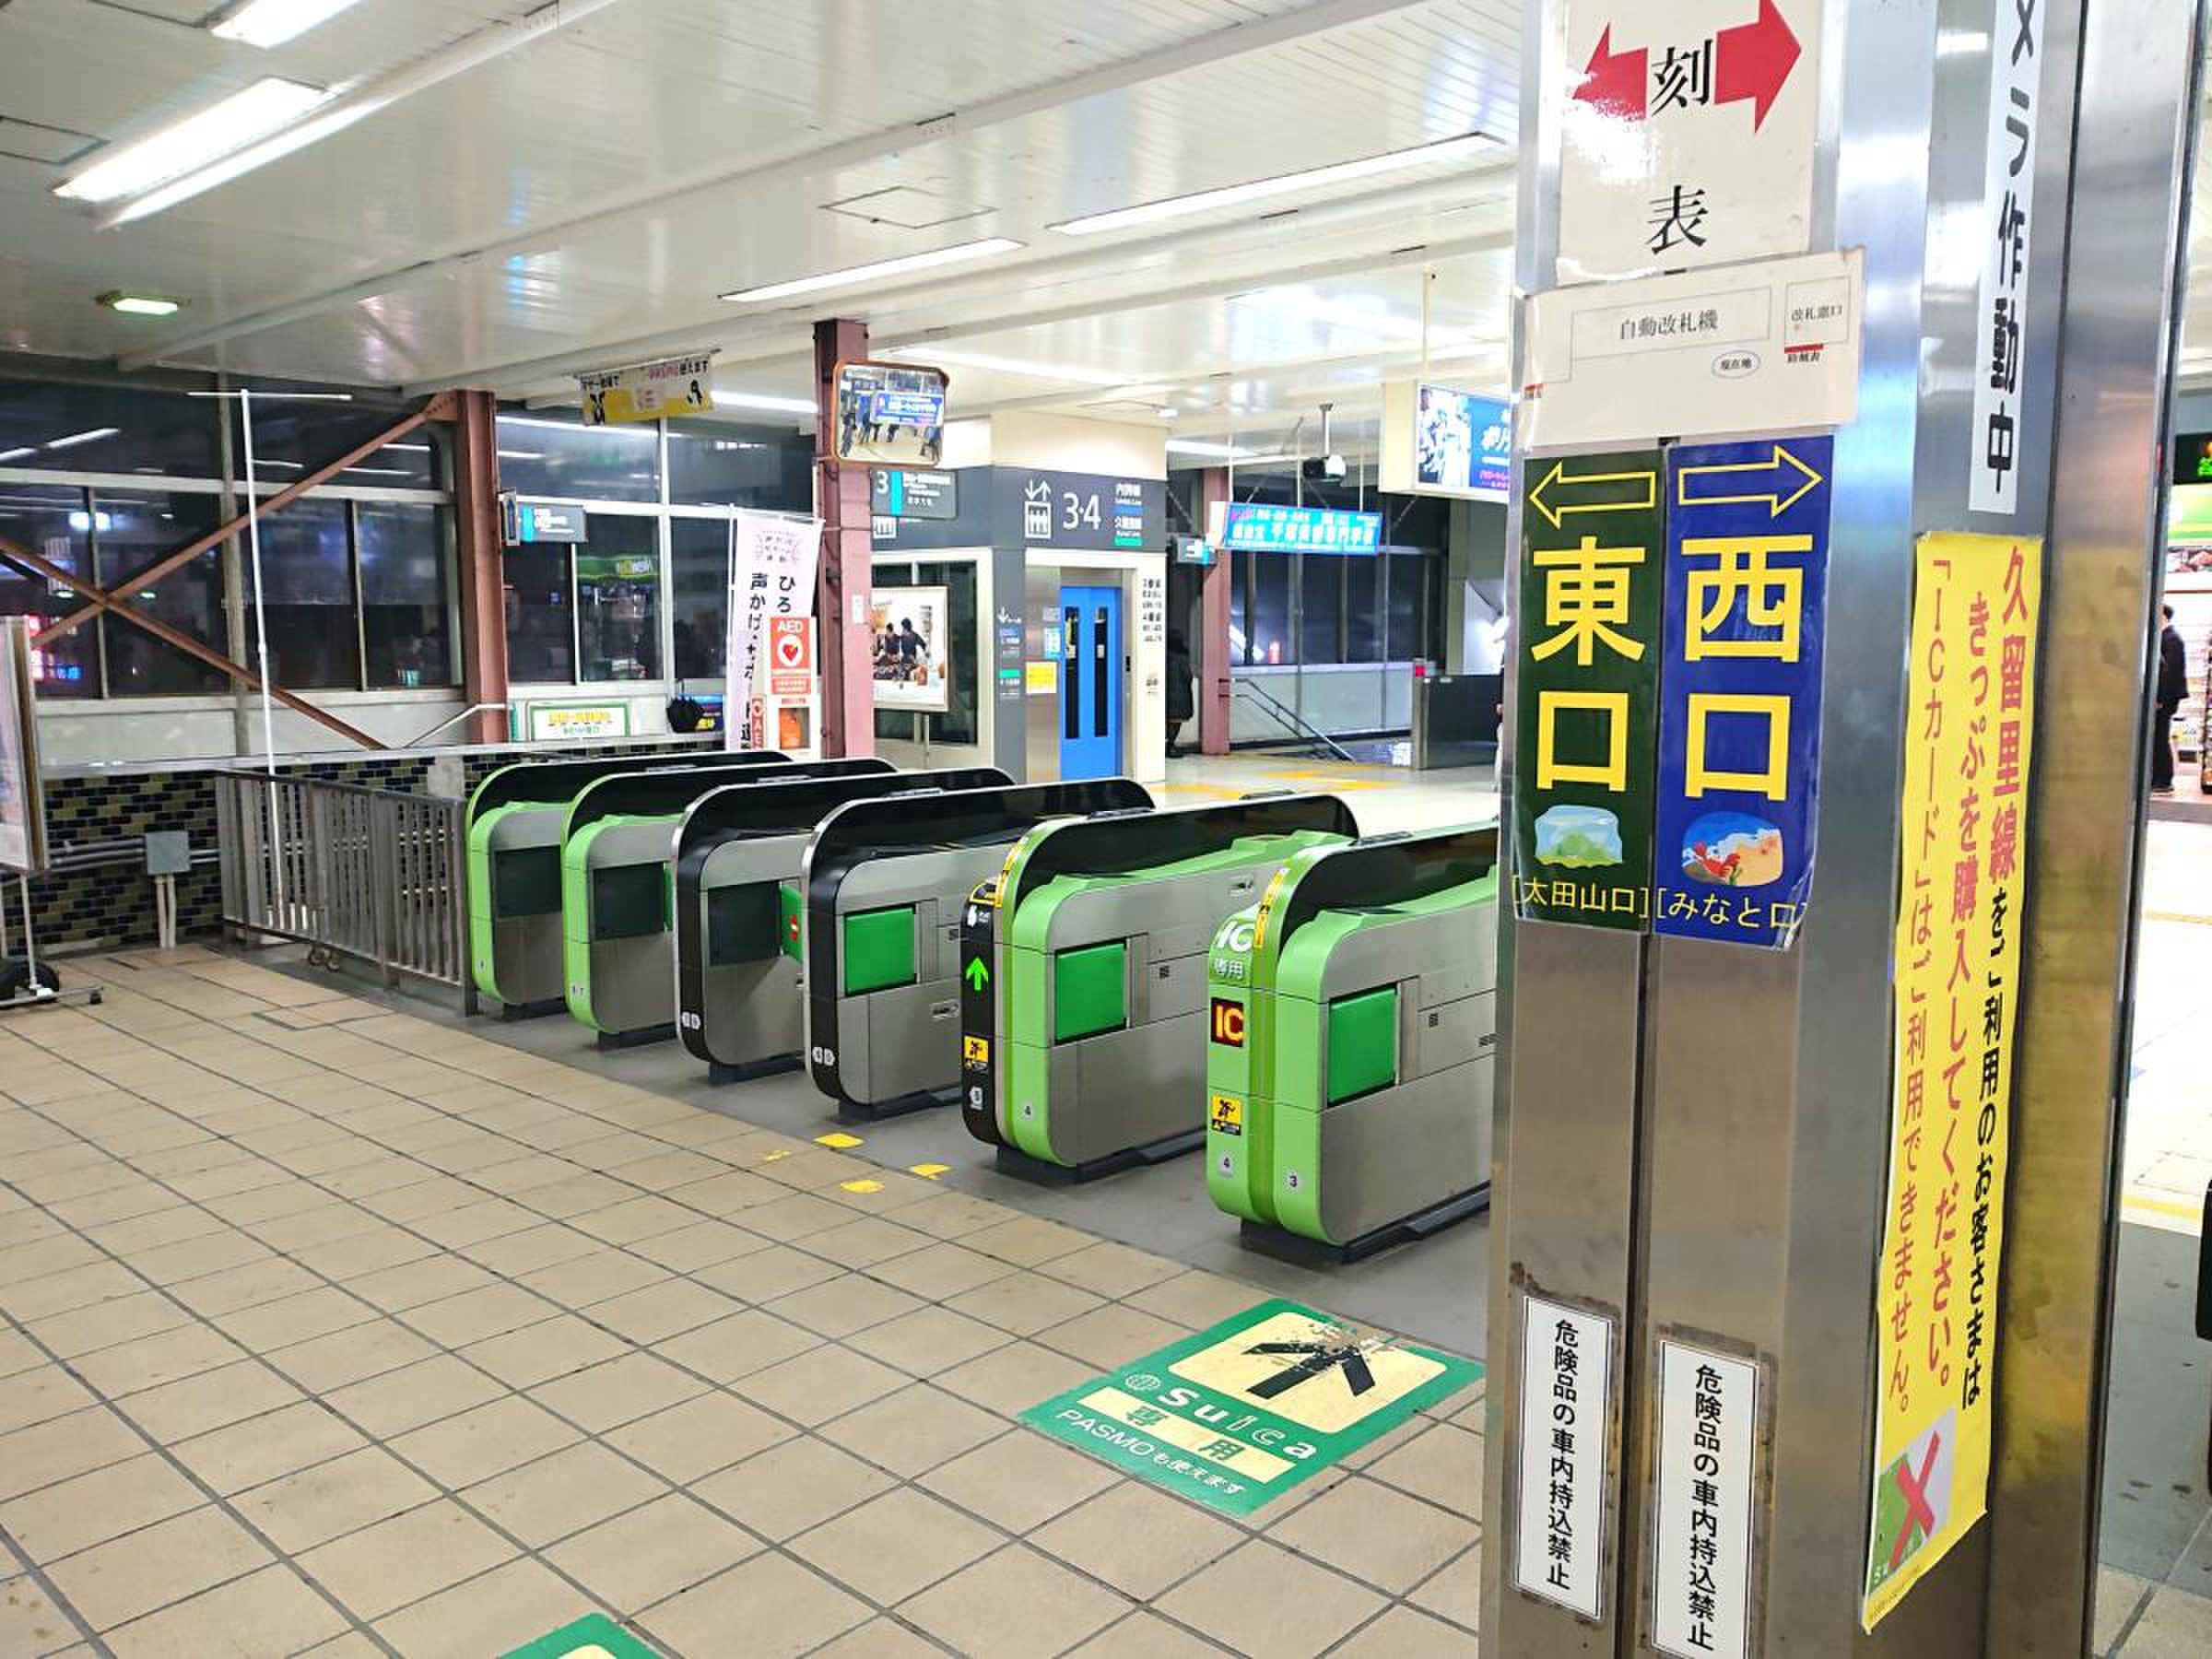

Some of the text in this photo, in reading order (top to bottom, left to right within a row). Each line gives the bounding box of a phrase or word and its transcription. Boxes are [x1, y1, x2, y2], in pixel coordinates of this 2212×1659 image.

[1645, 39, 1713, 275] 刻表
[1987, 0, 2034, 493] メラ作動中
[1620, 310, 1719, 340] 自動改札機
[877, 471, 889, 494] 3
[777, 620, 804, 632] AED
[1532, 536, 1645, 792] 東口
[1681, 534, 1813, 801] 西口
[1216, 921, 1256, 952] IC
[1216, 1005, 1243, 1042] IC
[1929, 592, 1989, 1386] きっぷを購入してください。
[1222, 1156, 1231, 1169] 4
[1289, 1175, 1299, 1188] 3
[1055, 1409, 1247, 1495] PASMOも使えます
[1158, 1386, 1317, 1460] Suica
[1547, 1319, 1579, 1590] 危険品の車内持込禁止
[1687, 1364, 1723, 1651] 危険品の車内持込禁止
